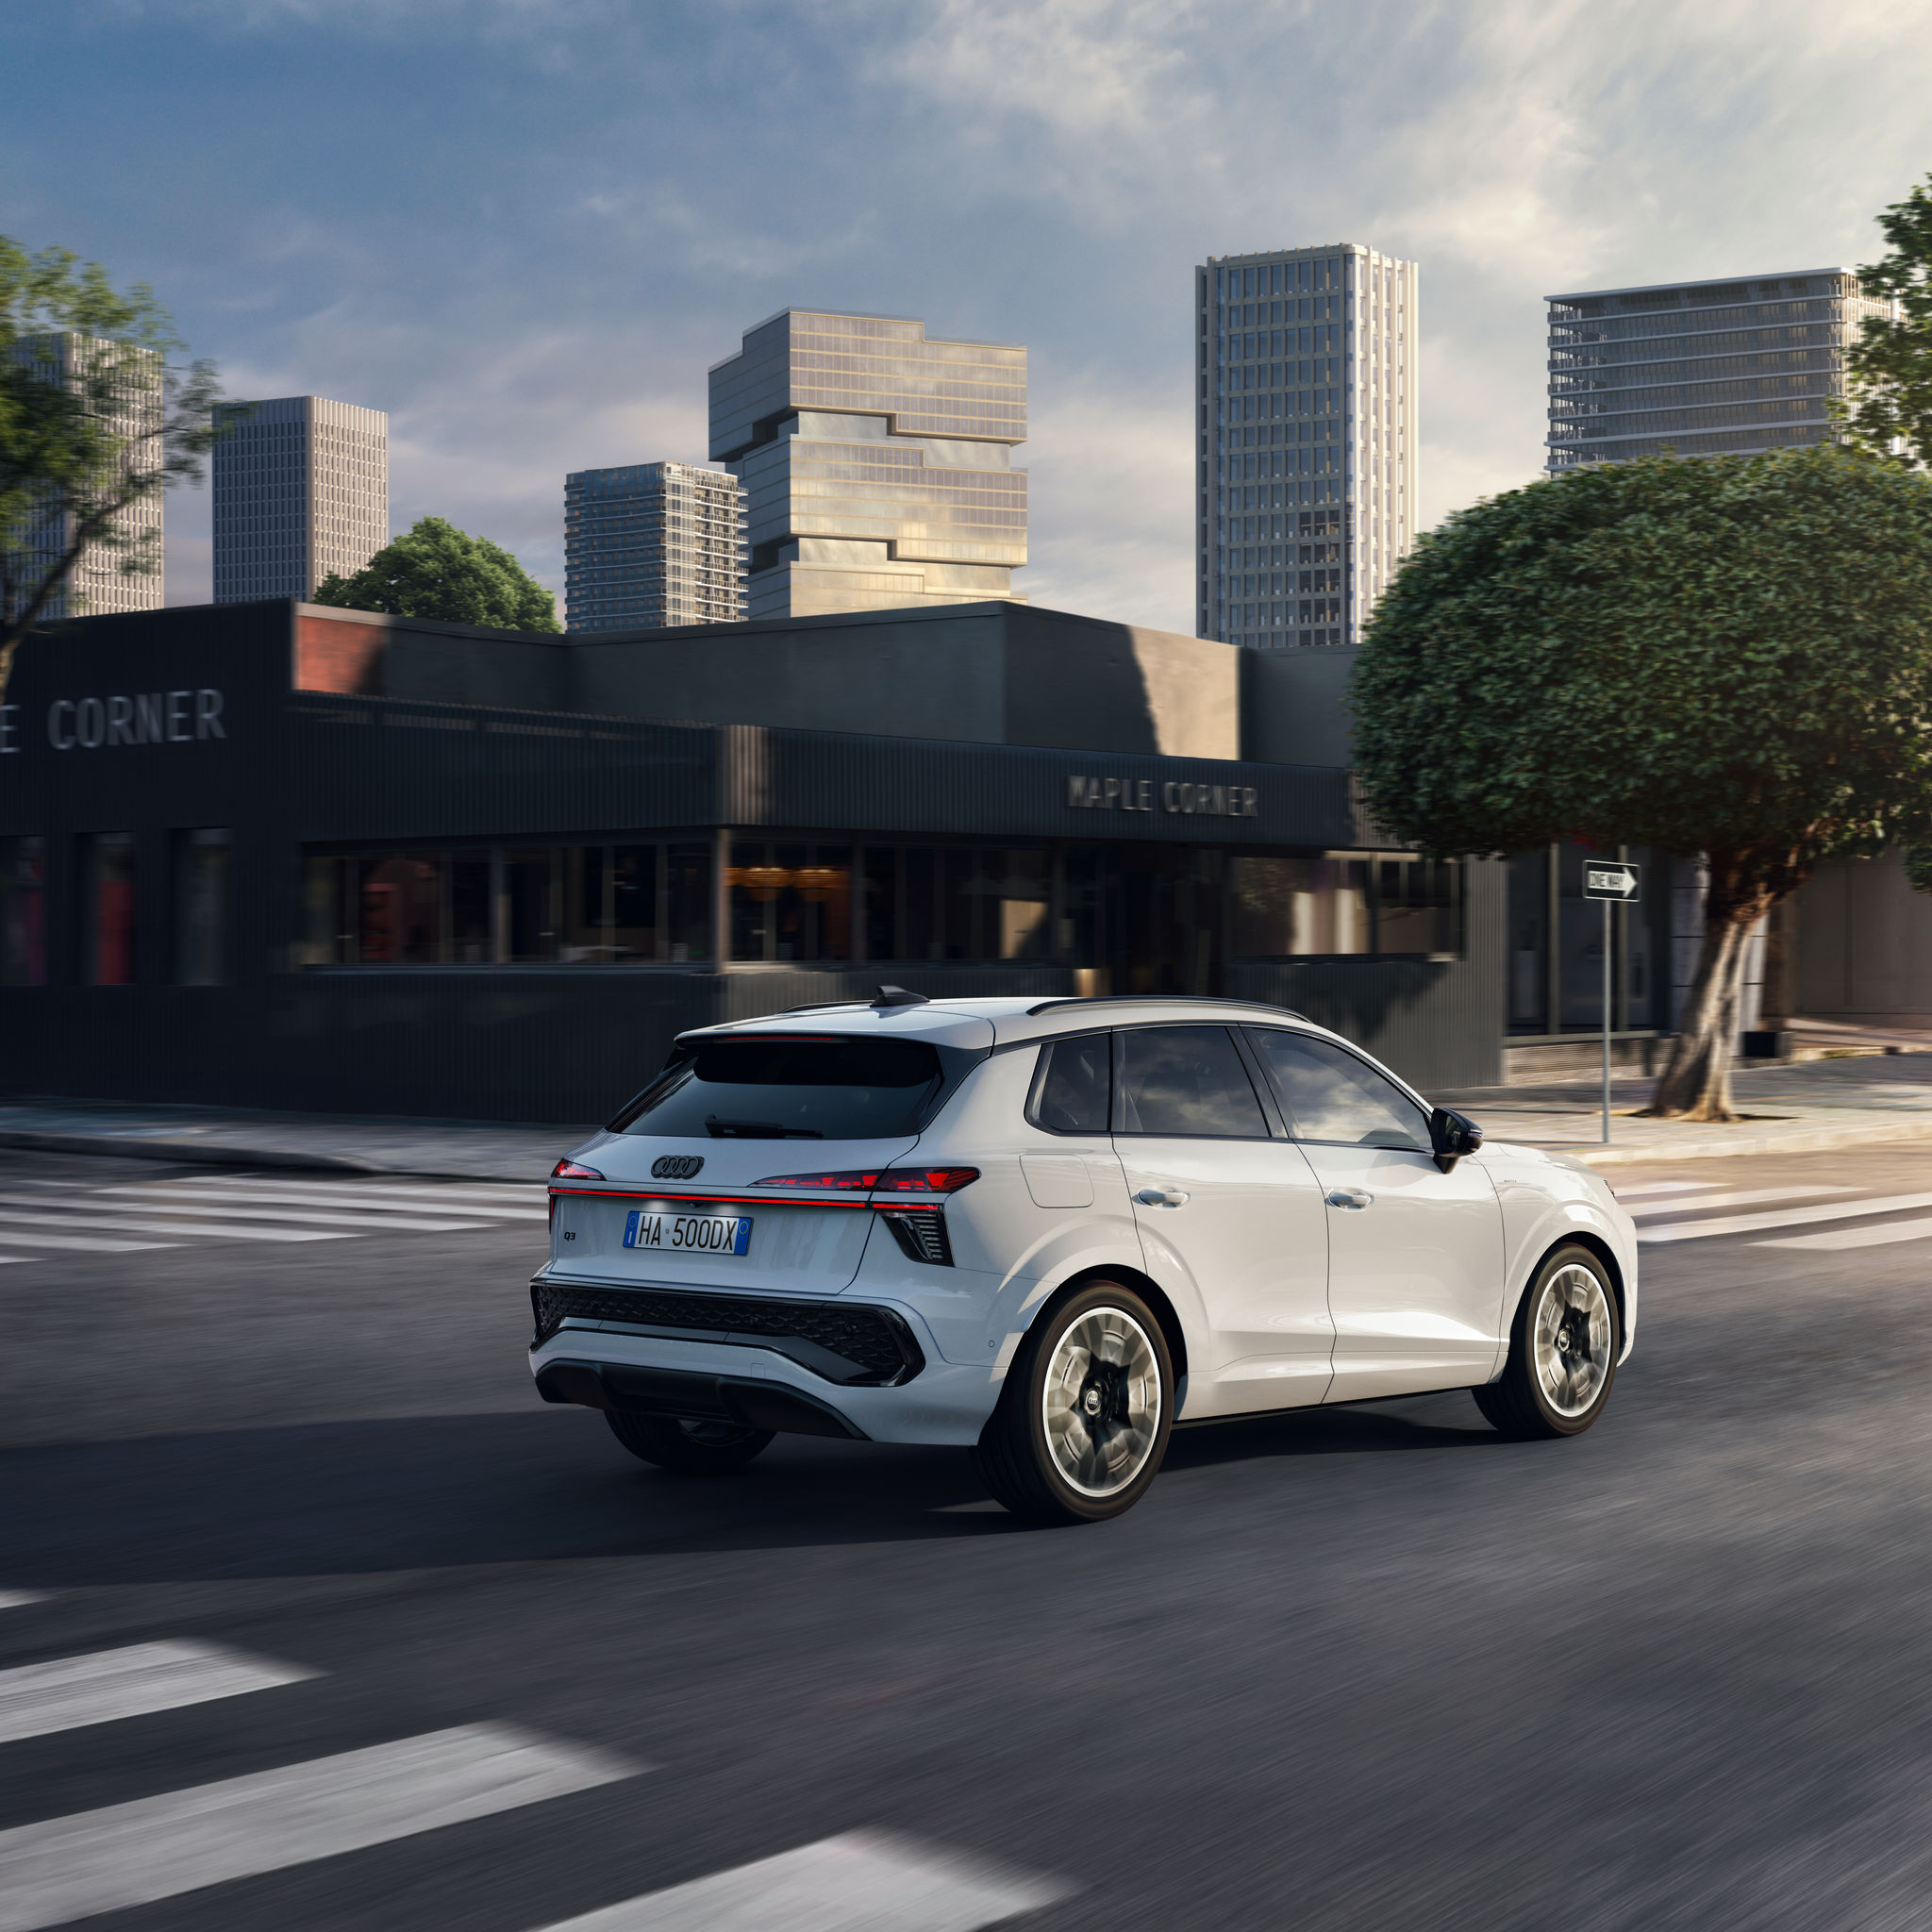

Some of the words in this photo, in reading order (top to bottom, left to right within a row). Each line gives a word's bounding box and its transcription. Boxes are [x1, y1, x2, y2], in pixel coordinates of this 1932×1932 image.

[48, 689, 227, 750] CORNER
[1067, 774, 1153, 811] MAPLE
[1164, 781, 1258, 817] CORNER
[564, 1231, 575, 1241] Q3
[638, 1215, 661, 1245] HA
[672, 1218, 737, 1251] 500DX
